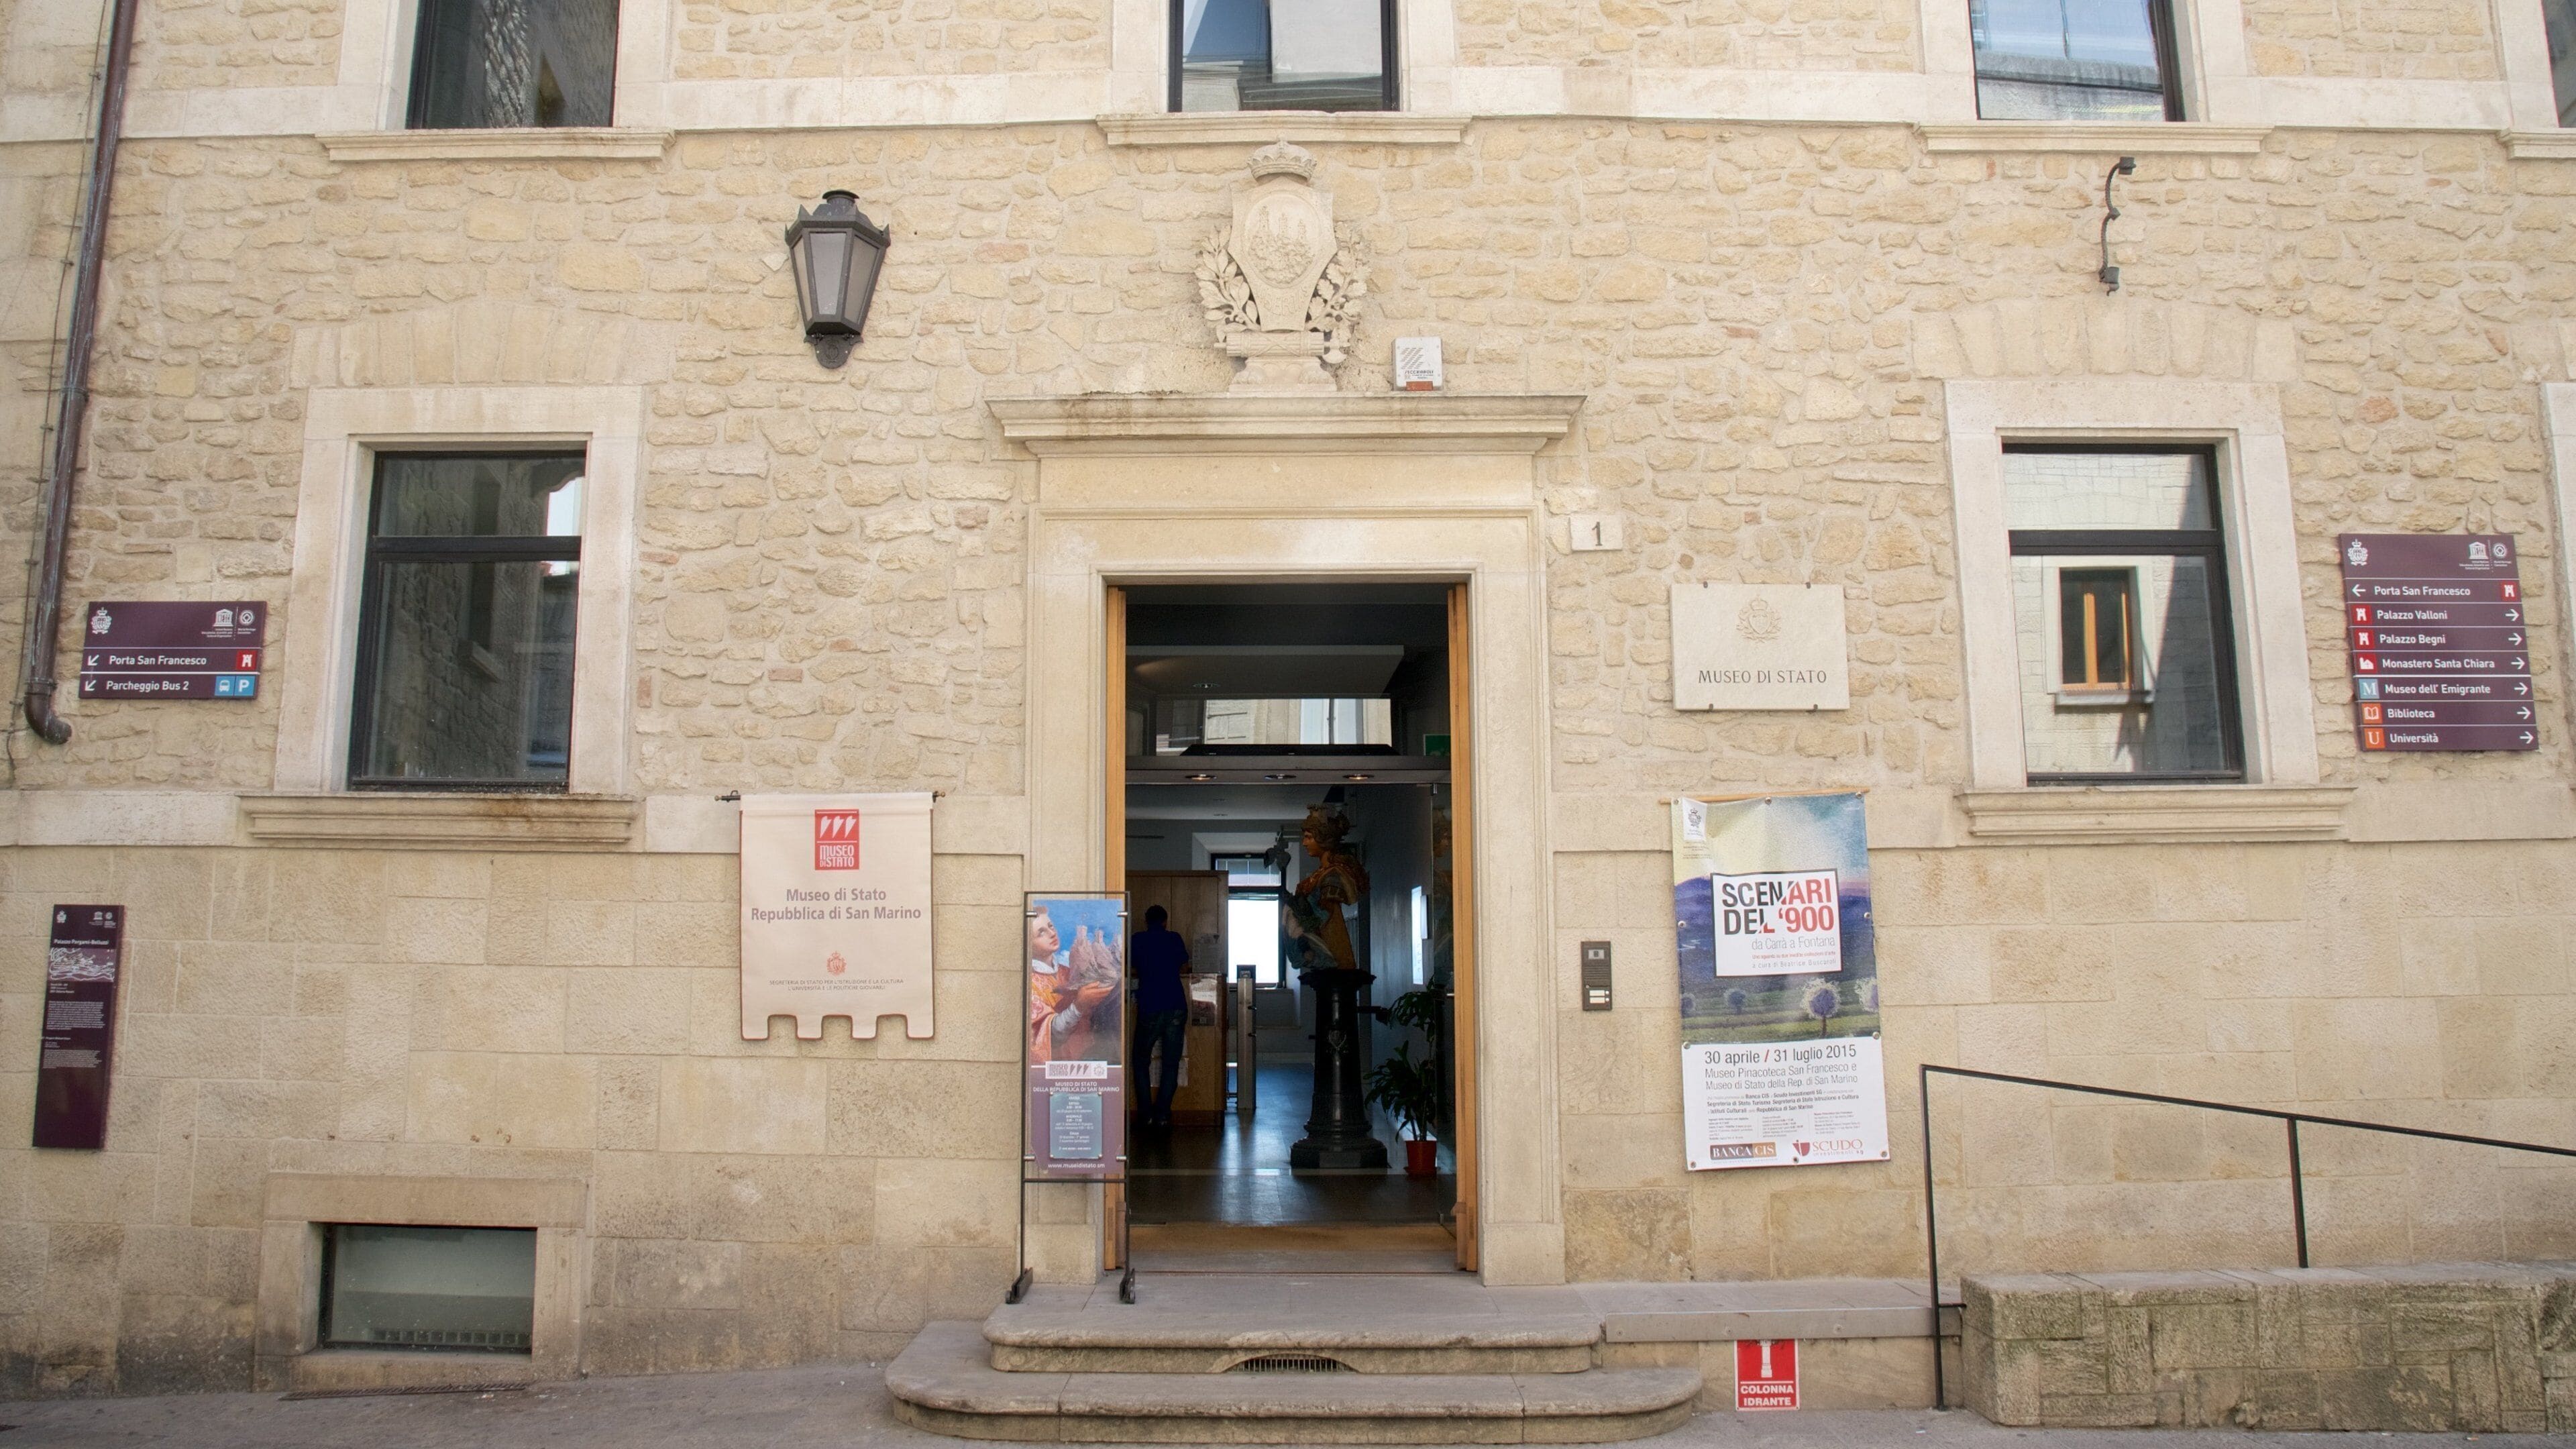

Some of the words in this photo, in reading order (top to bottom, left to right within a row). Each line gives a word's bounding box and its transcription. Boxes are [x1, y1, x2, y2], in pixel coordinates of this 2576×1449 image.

[1592, 521, 1603, 546] 1
[2375, 586, 2400, 596] Porta
[2403, 586, 2420, 596] San
[2423, 586, 2470, 596] Francesco
[2377, 610, 2413, 619] Palazzo
[2416, 610, 2447, 619] Valloni
[2380, 635, 2416, 643] Palazzo
[2418, 635, 2446, 645] Begni
[109, 656, 134, 665] Porta
[138, 656, 155, 665] San
[158, 656, 207, 665] Francesco
[2383, 659, 2432, 668] Monastero
[2434, 659, 2461, 668] Santa
[2464, 659, 2495, 668] Chiara
[1699, 670, 1751, 684] MUSEO
[1758, 671, 1771, 683] DI
[1774, 670, 1827, 683] STATO
[107, 682, 159, 692] Parcheggio
[162, 682, 180, 690] Bus
[182, 682, 189, 690] 2
[239, 680, 249, 692] P
[2385, 684, 2416, 694] Museo
[2418, 684, 2438, 694] dell'
[2442, 684, 2491, 695] Emigrante
[2388, 709, 2434, 718] Biblioteca
[2390, 733, 2438, 743] Università
[820, 845, 854, 859] MUSEO
[826, 857, 854, 867] STATO
[787, 890, 830, 902] Museo
[835, 889, 847, 900] di
[852, 888, 886, 900] Stato
[1722, 879, 1832, 907] SCENARI
[752, 908, 824, 923] Repubblica
[829, 907, 841, 919] di
[847, 907, 869, 919] San
[874, 906, 920, 918] Marino
[1724, 909, 1775, 934] DEL
[1752, 938, 1763, 950] da
[1766, 937, 1787, 949] Carrà
[1790, 940, 1795, 948] a
[1799, 936, 1835, 948] Fontana
[1705, 1051, 1720, 1064] 30
[1725, 1051, 1759, 1065] aprile
[1764, 1050, 1769, 1062] /
[1774, 1050, 1787, 1062] 31
[1793, 1048, 1822, 1062] luglio
[1827, 1044, 1856, 1059] 2015
[1705, 1068, 1735, 1078] Museo
[1739, 1067, 1786, 1077] Pinacoteca
[1788, 1065, 1804, 1075] San
[1807, 1063, 1848, 1075] Francesco
[1707, 1081, 1731, 1089] Museo
[1735, 1081, 1741, 1089] di
[1745, 1080, 1765, 1089] Stato
[1768, 1079, 1785, 1088] della
[1788, 1079, 1803, 1087] Rep.
[1807, 1077, 1813, 1085] di
[1815, 1076, 1828, 1084] San
[1831, 1075, 1857, 1083] Marino
[1713, 1147, 1752, 1157] BANCA
[1755, 1145, 1774, 1155] CIS
[1813, 1139, 1862, 1151] SCUDO
[1741, 1385, 1794, 1394] COLONNA
[1743, 1397, 1791, 1405] IDRANTE
